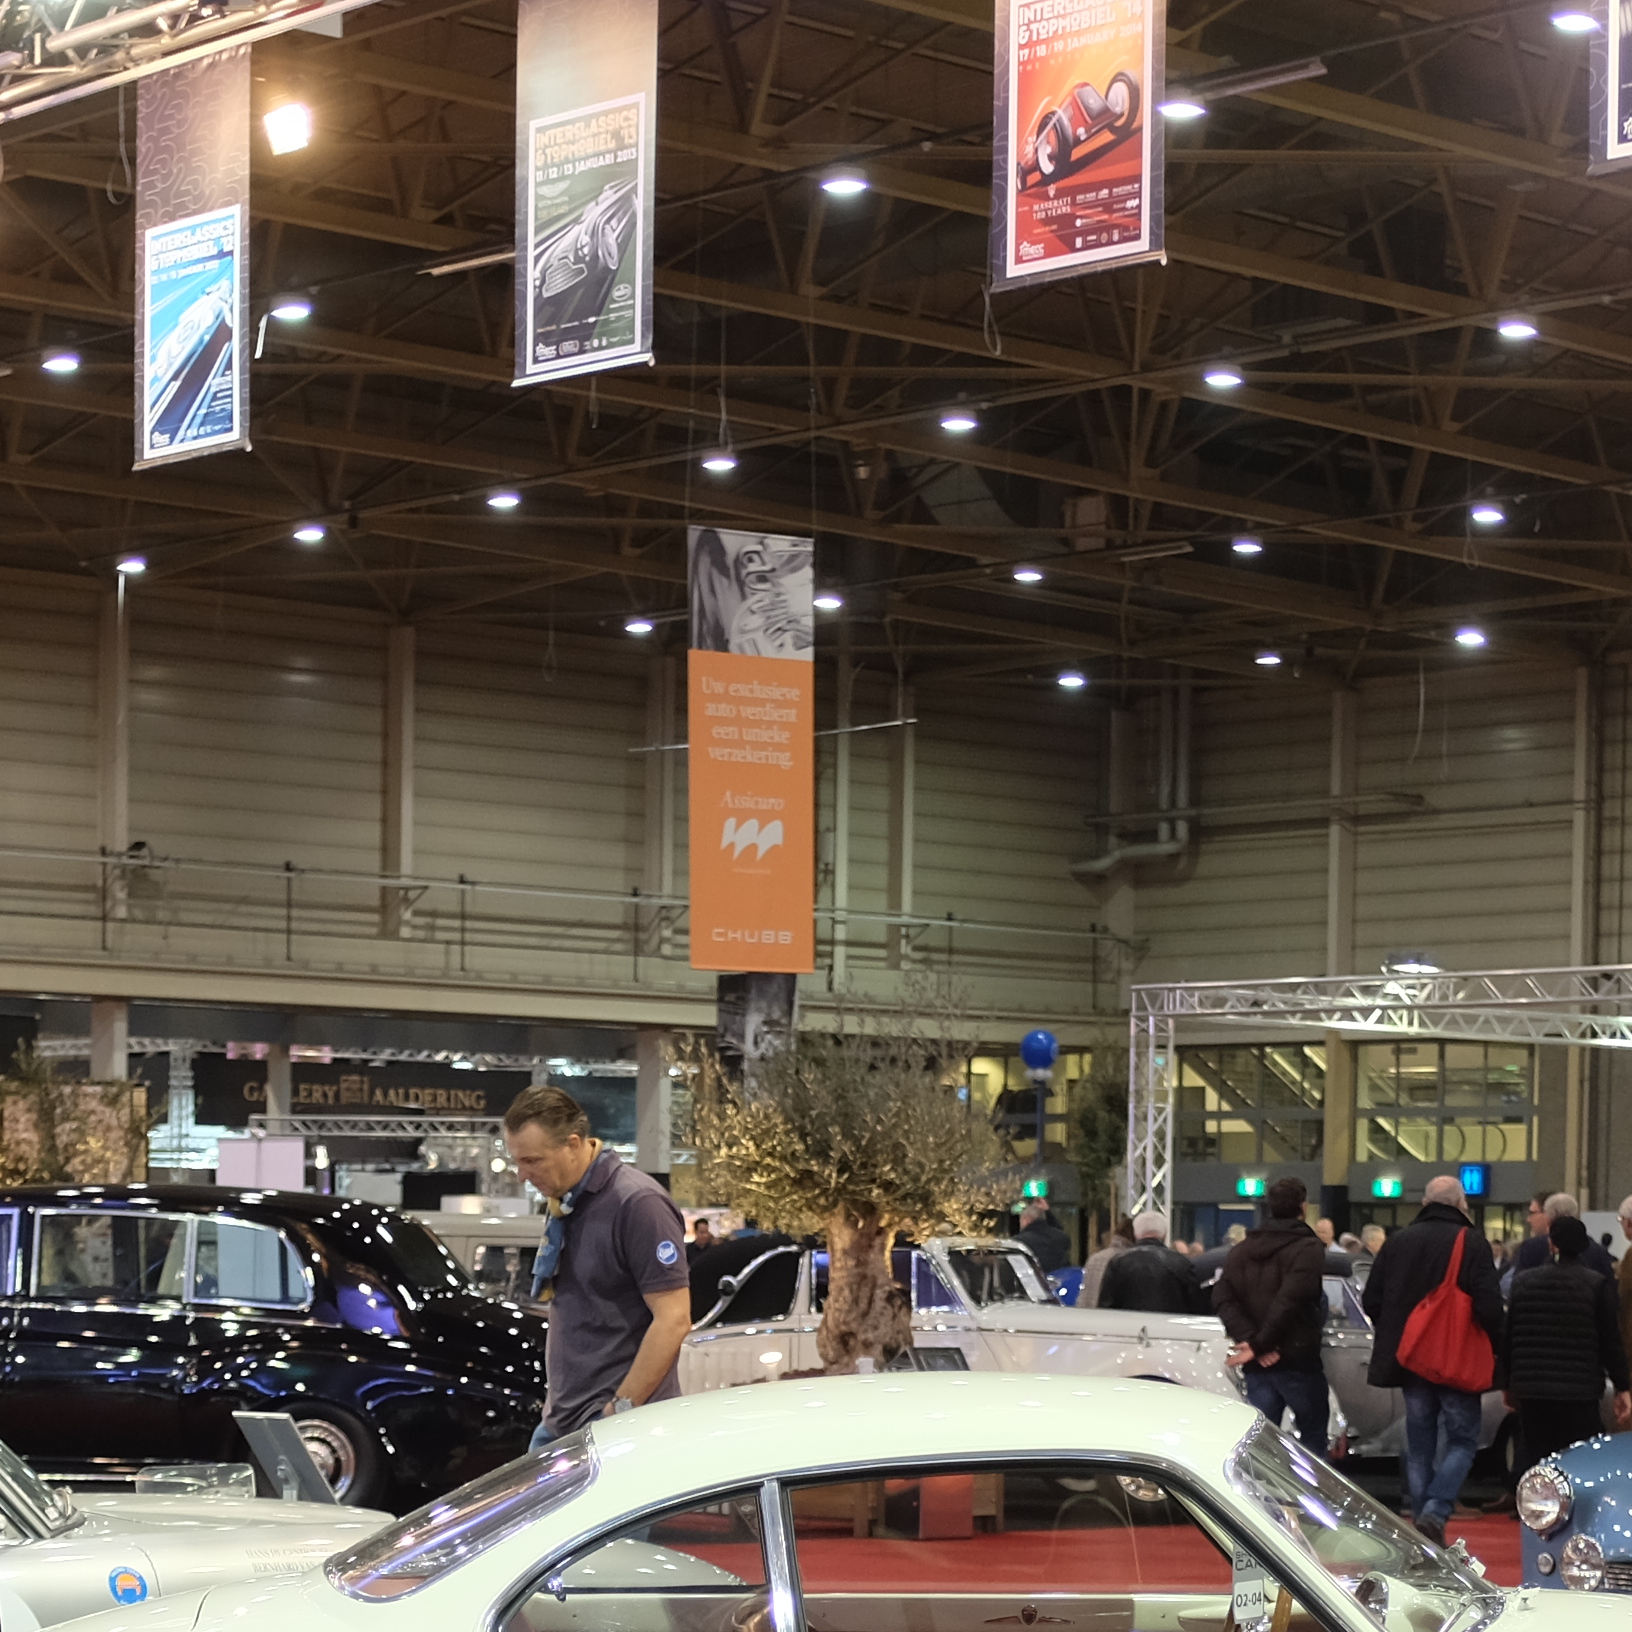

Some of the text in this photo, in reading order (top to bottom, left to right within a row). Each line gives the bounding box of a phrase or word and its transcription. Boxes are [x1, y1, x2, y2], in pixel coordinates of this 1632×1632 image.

[536, 109, 637, 148] INTERCLASSICS
[575, 153, 614, 175] JANUARI
[701, 677, 801, 701] Uw exclusieve
[705, 703, 798, 722] auto verdient
[712, 725, 792, 743] een unieke
[712, 929, 793, 944] CHUBB
[243, 1082, 486, 1111] GAERY AALDERING
